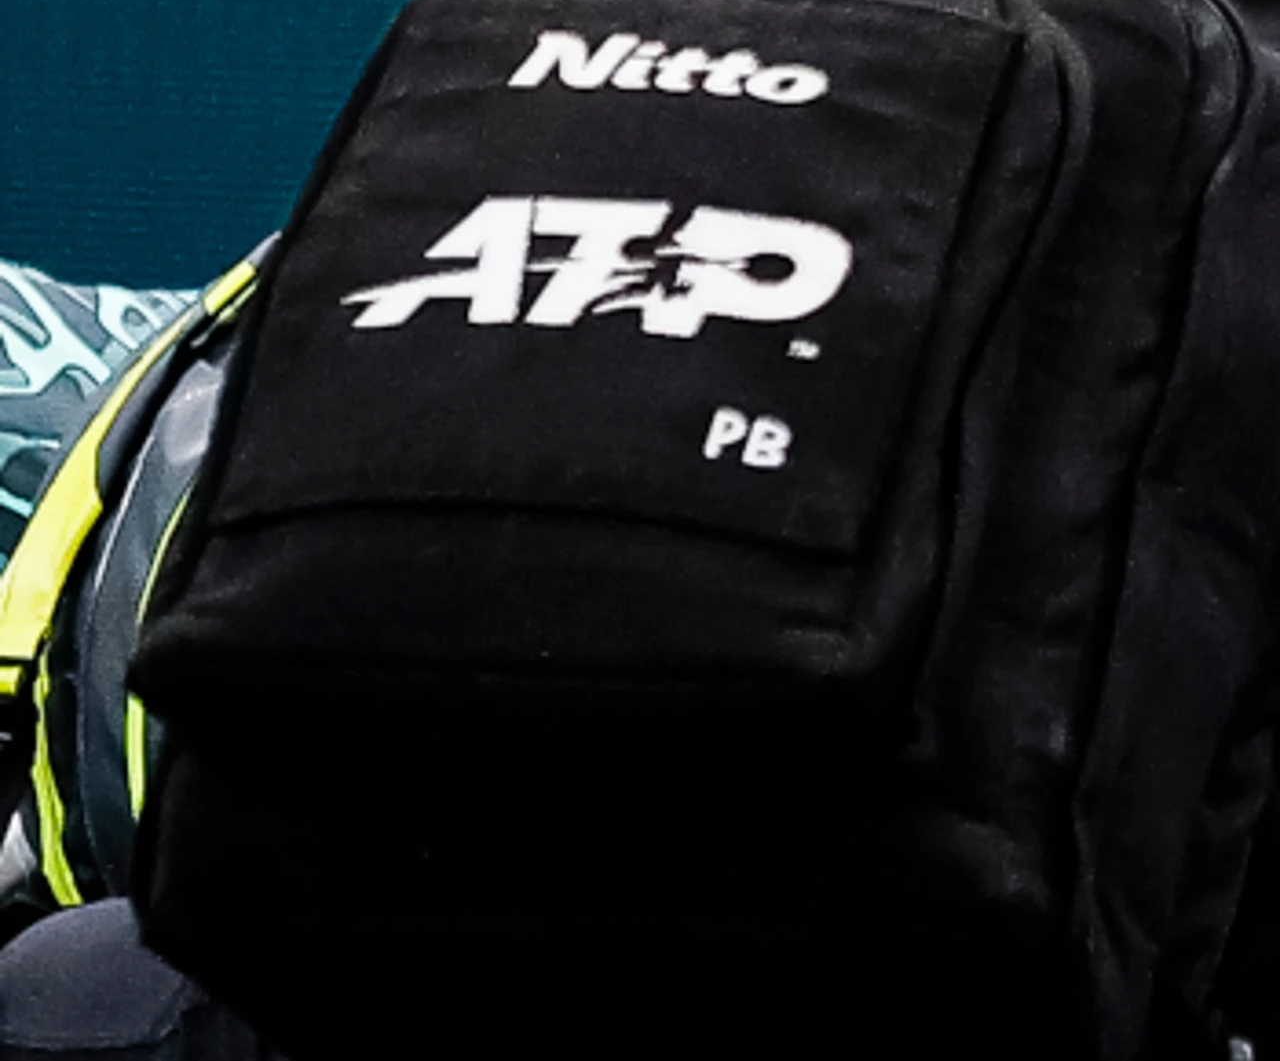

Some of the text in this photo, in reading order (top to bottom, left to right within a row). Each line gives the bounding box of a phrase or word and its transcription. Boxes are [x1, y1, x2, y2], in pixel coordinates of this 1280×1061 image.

[508, 30, 829, 104] Nitto
[340, 195, 853, 338] ATP
[703, 407, 792, 468] PB
